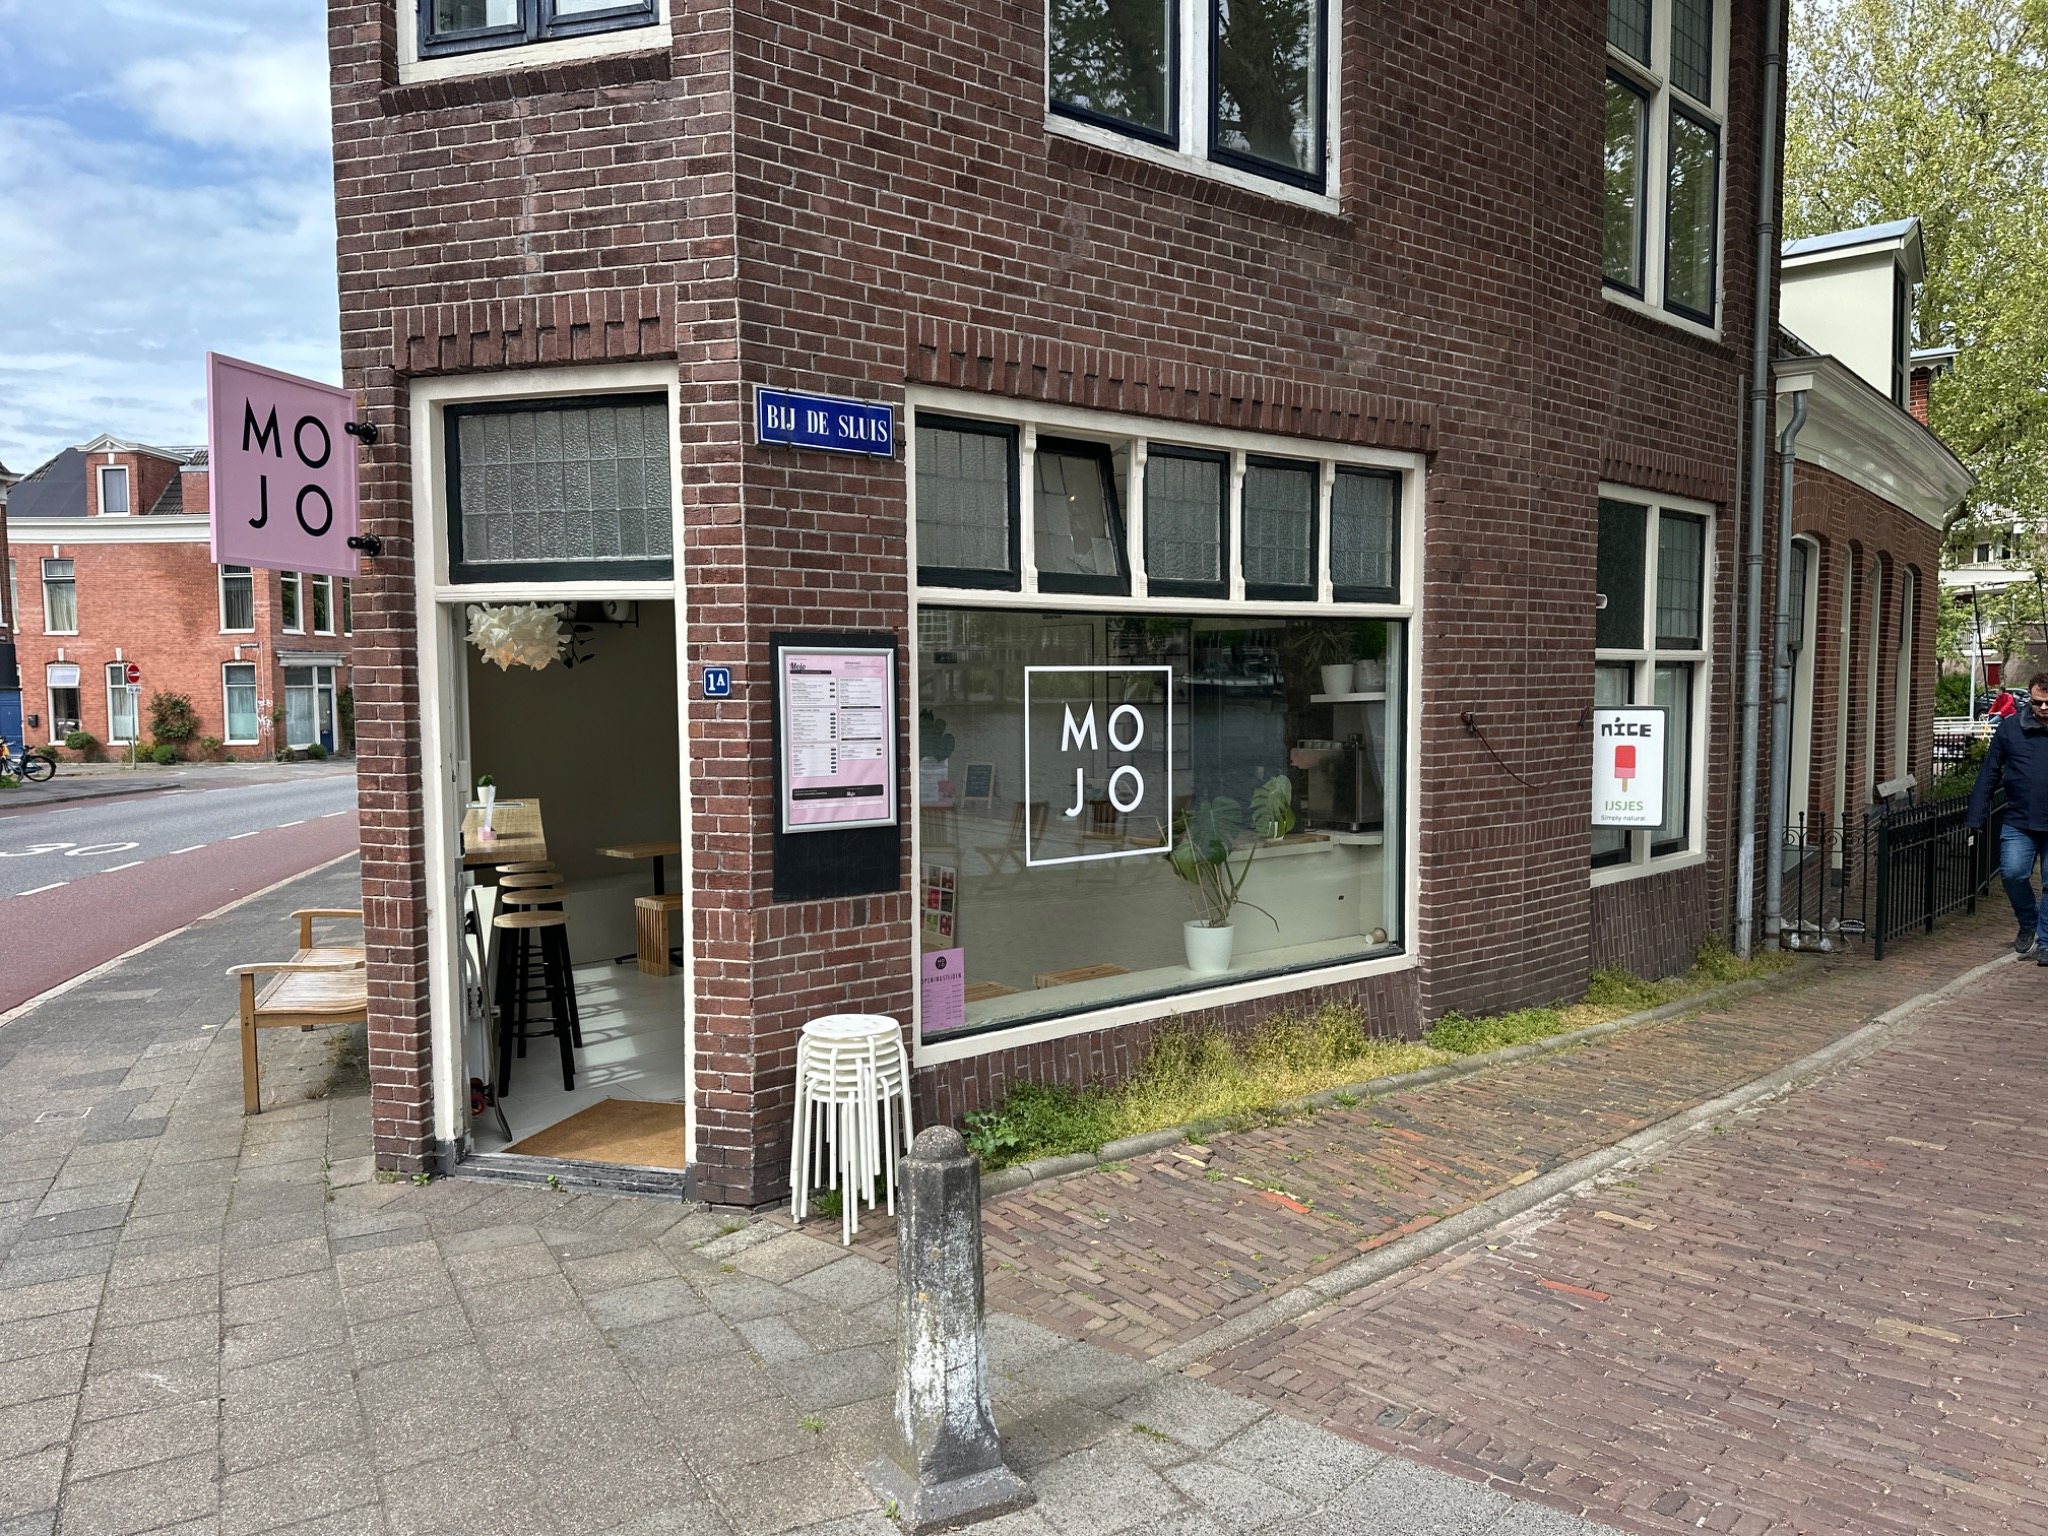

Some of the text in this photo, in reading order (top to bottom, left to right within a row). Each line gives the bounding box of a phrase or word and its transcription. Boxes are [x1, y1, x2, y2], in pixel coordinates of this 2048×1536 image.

[241, 397, 332, 469] MO
[766, 403, 888, 443] BIJ DE SLUIS
[248, 474, 334, 538] JO
[707, 673, 727, 692] 1A
[1060, 701, 1145, 752] MO
[1064, 764, 1145, 818] JO
[1605, 800, 1644, 811] IJSJES
[1600, 814, 1622, 822] Simply
